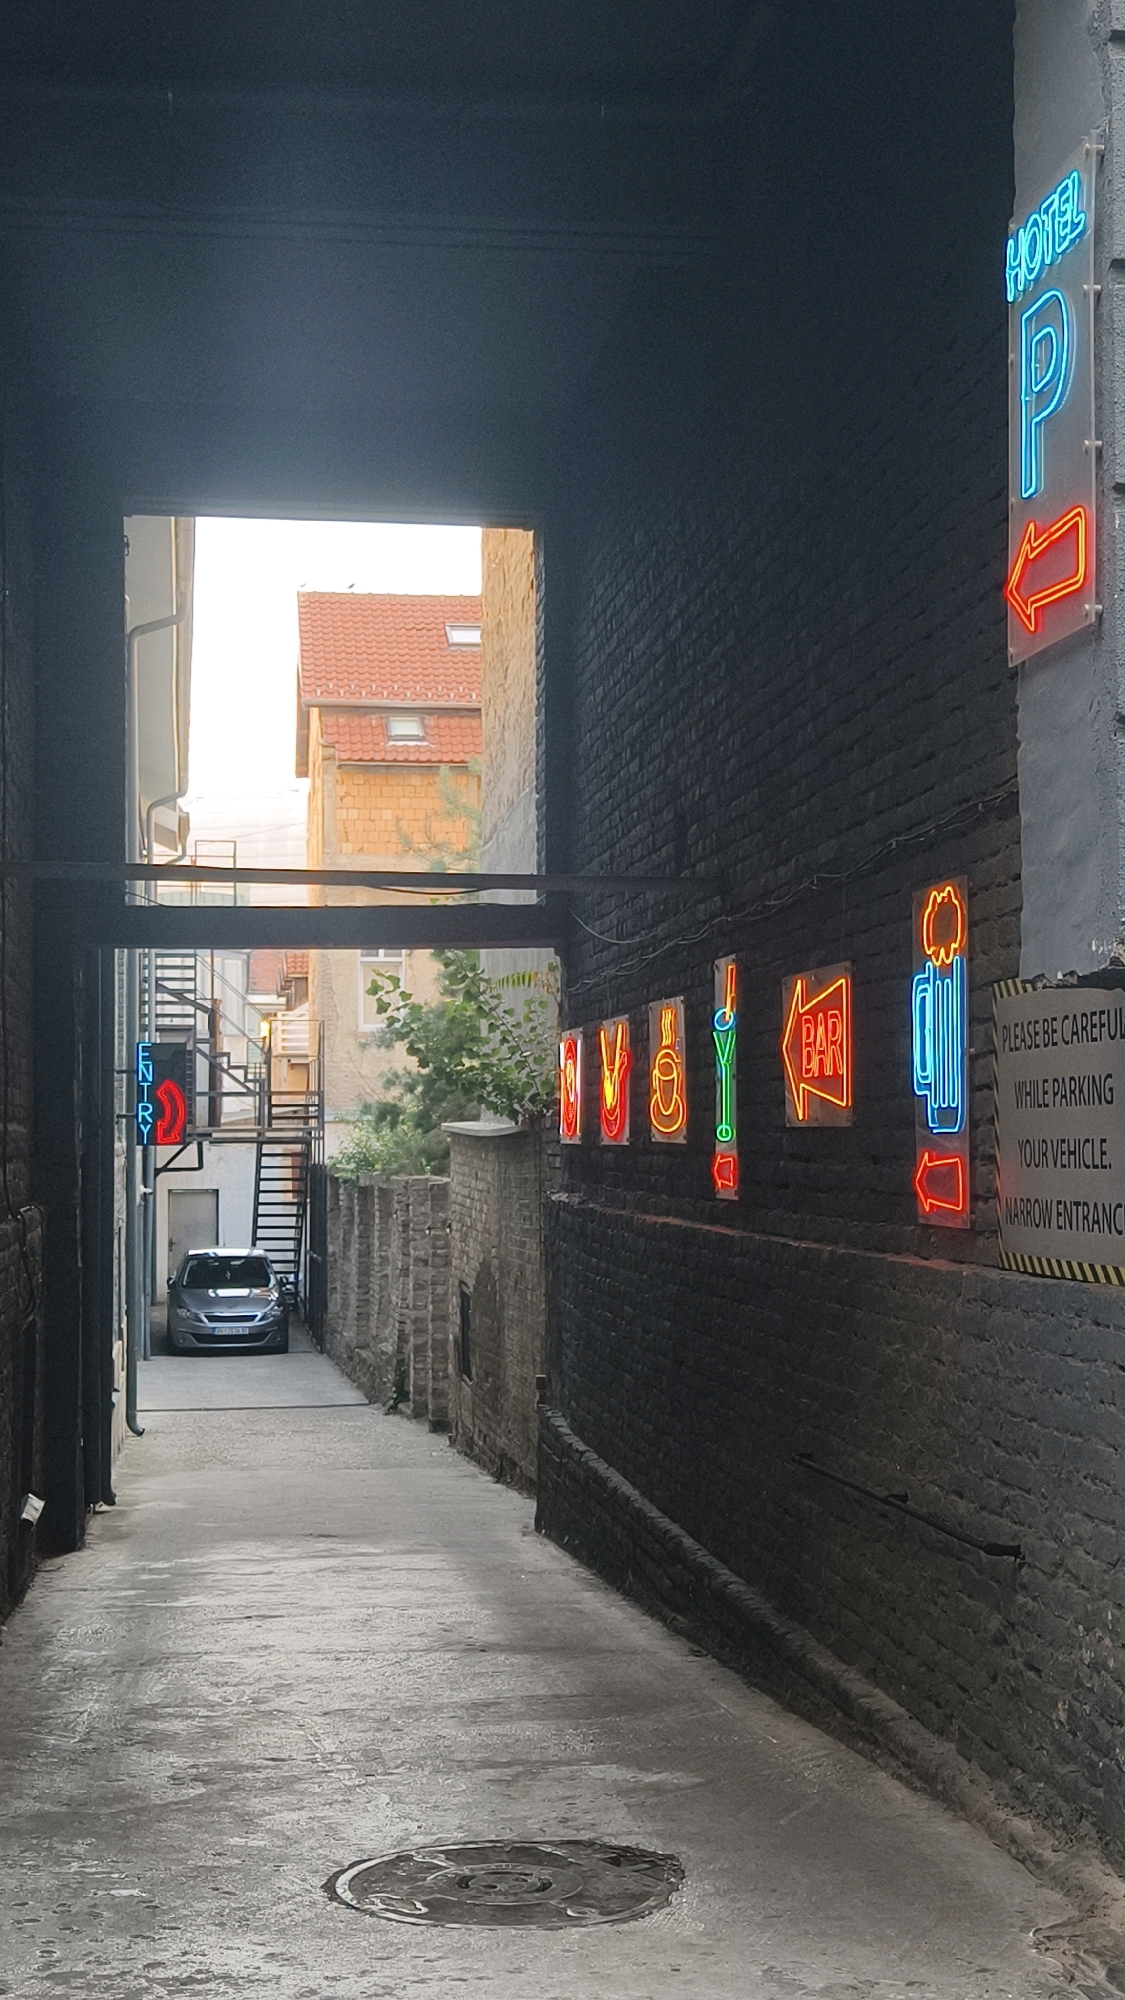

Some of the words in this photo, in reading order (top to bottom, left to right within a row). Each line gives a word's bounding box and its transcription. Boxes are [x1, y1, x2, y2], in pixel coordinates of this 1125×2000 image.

[1005, 170, 1086, 303] HOTEL
[1020, 289, 1069, 499] P
[801, 1010, 844, 1078] BAR
[1002, 1019, 1040, 1053] PLEASE
[1042, 1016, 1058, 1048] BE
[1061, 1006, 1125, 1046] CAREFUL
[137, 1042, 154, 1145] ENTRY
[1014, 1078, 1050, 1110] WHILE
[1052, 1072, 1114, 1108] PARKING
[1017, 1138, 1049, 1169] YOUR
[1050, 1137, 1112, 1170] VEHICLE.
[1005, 1196, 1053, 1230] NARROW
[1056, 1199, 1125, 1236] ENTRANC
